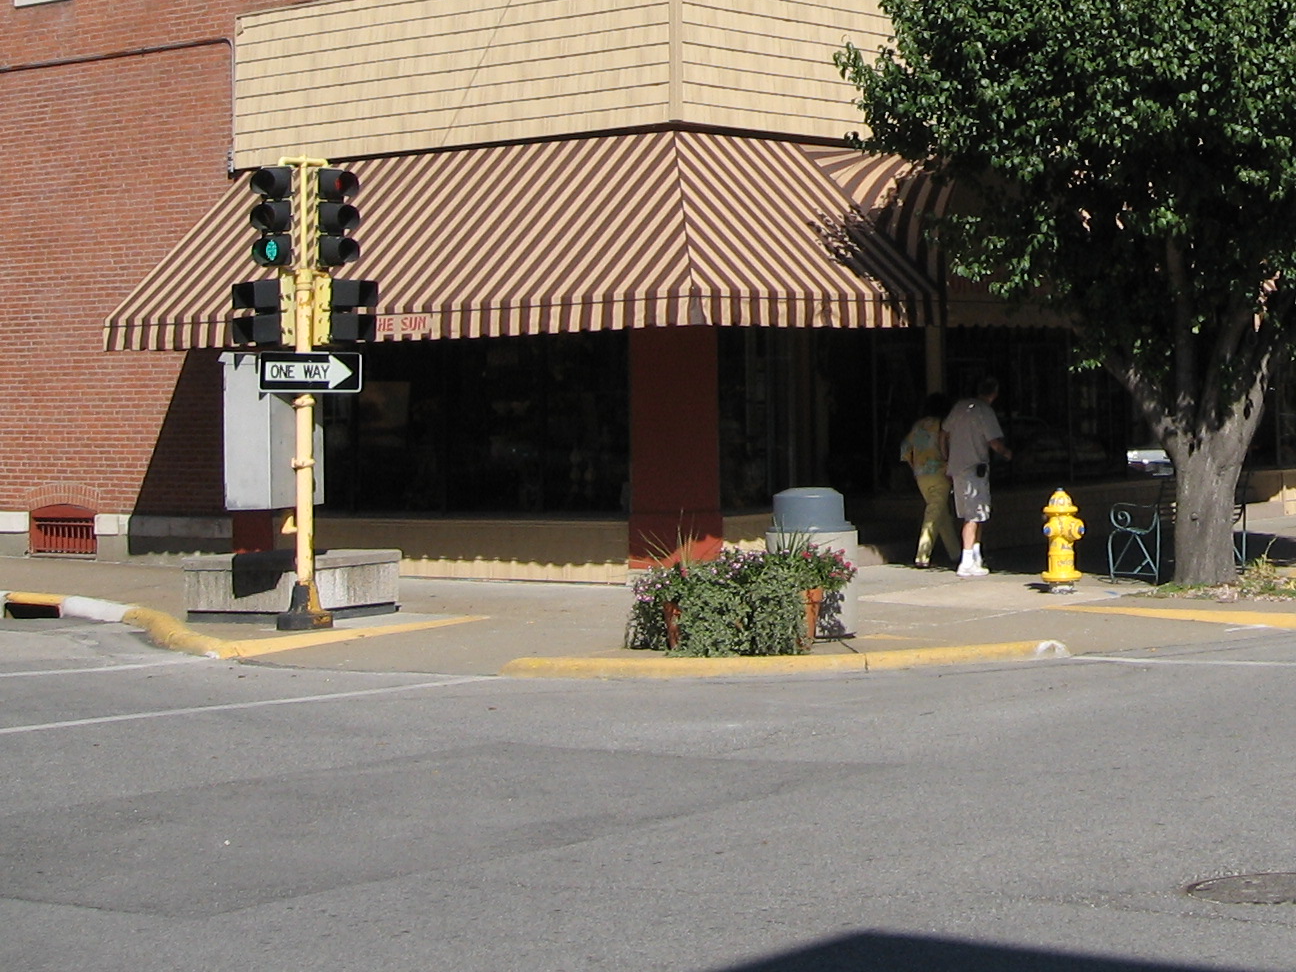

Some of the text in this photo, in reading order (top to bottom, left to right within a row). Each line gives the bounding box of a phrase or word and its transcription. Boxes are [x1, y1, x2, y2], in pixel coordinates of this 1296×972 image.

[377, 315, 428, 332] HE SUN
[270, 364, 330, 379] ONE WAY
